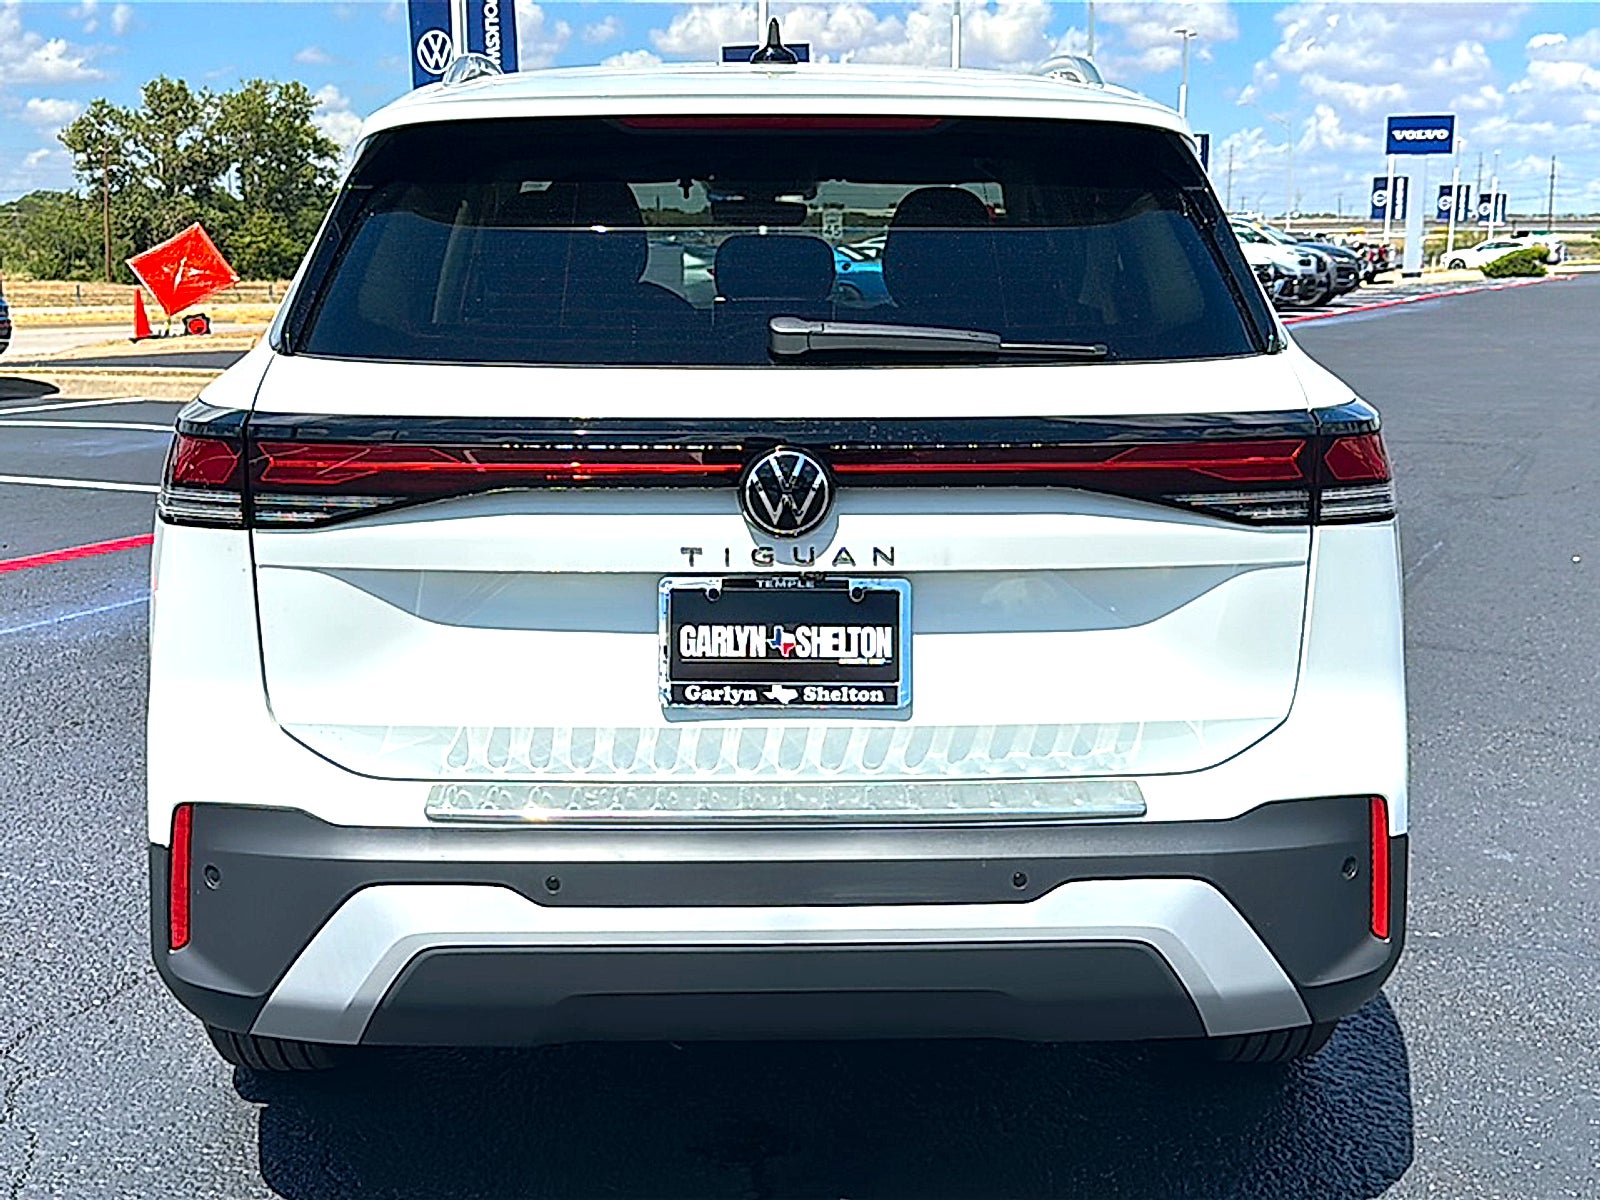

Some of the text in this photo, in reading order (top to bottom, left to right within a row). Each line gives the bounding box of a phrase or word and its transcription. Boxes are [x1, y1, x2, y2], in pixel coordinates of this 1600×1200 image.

[1392, 129, 1449, 140] VOLVO
[680, 546, 895, 567] TIGUAN
[756, 579, 815, 588] TEMPLE
[679, 625, 893, 658] GARLYN SHELTON
[684, 685, 885, 704] Garlyn Shelton
